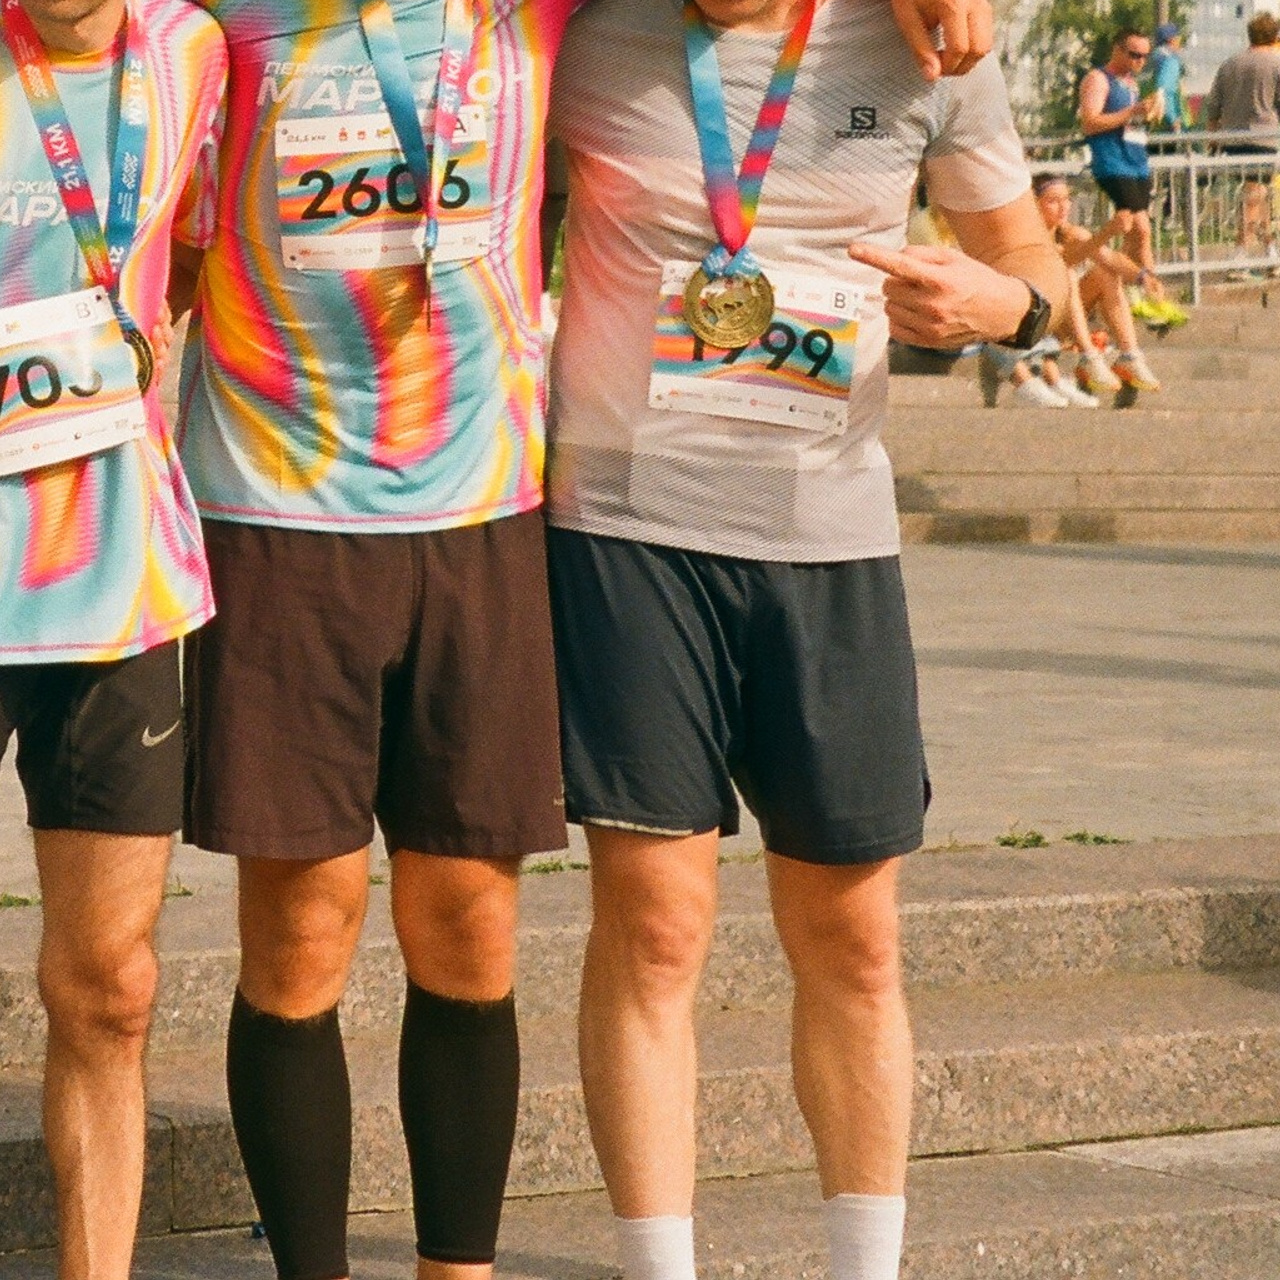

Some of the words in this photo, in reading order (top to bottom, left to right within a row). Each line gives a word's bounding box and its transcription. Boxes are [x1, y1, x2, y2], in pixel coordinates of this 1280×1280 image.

[58, 157, 81, 190] 21,1
[298, 159, 469, 220] 2606
[692, 322, 834, 378] 99
